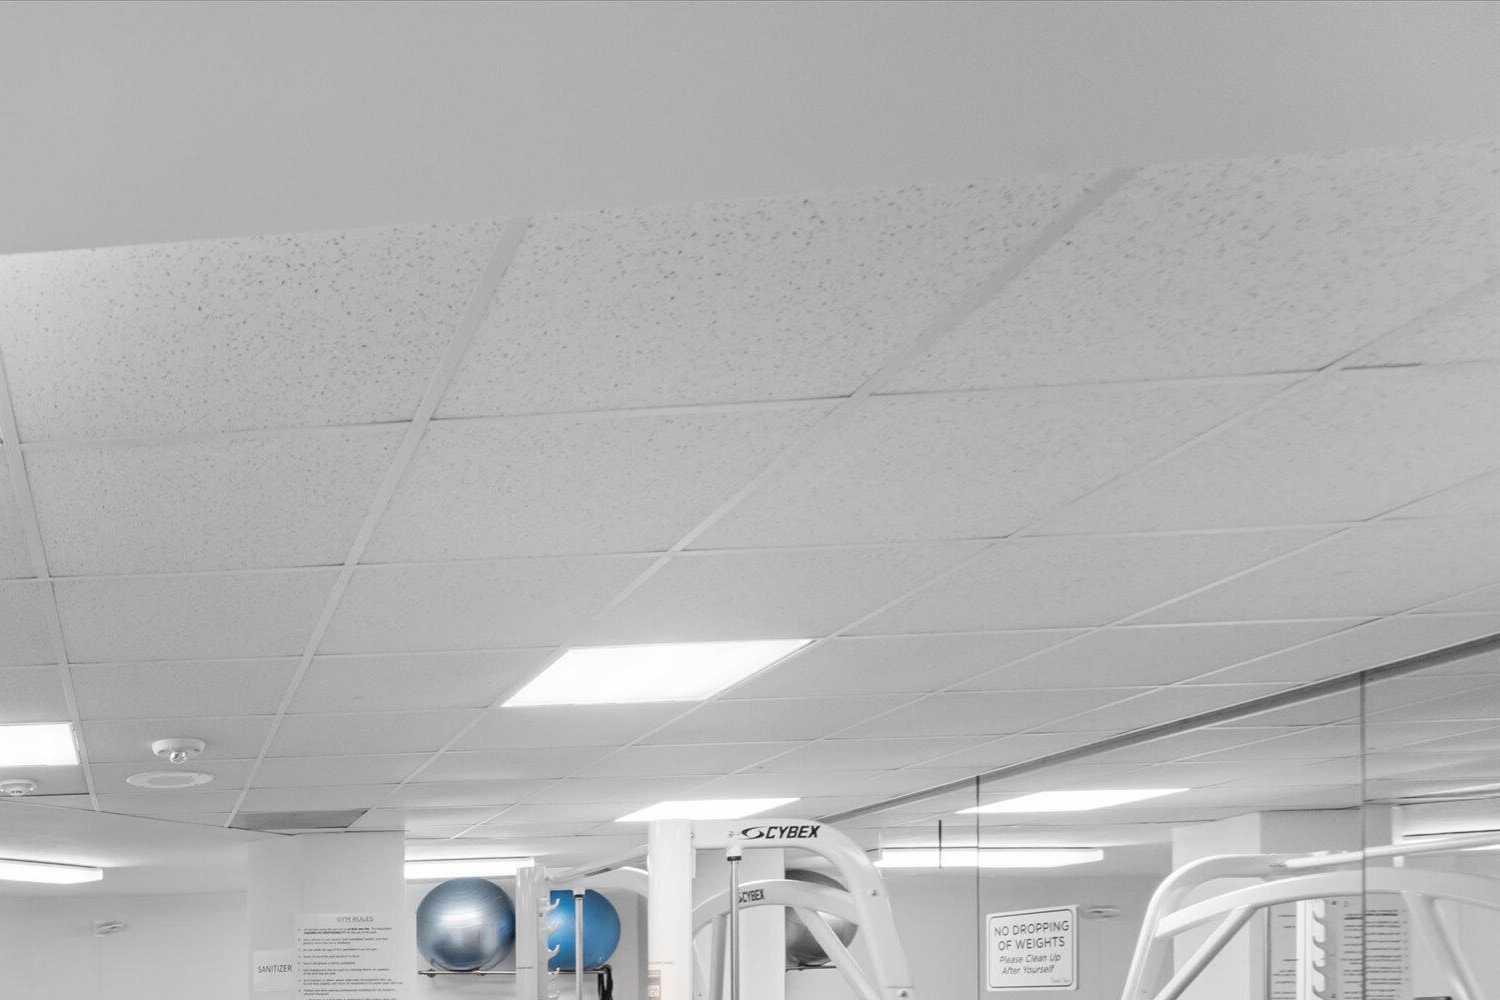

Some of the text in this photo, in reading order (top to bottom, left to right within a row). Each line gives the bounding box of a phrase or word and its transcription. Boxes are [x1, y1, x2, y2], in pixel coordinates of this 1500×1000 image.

[765, 825, 820, 839] CYBEX
[742, 889, 765, 903] CYBEX
[995, 920, 1069, 936] NO DROPPING
[998, 936, 1065, 951] OF WEIGHTS
[1000, 953, 1061, 963] Please Clean Up
[258, 964, 292, 974] SANITIZER
[1002, 964, 1055, 975] After Yourself
